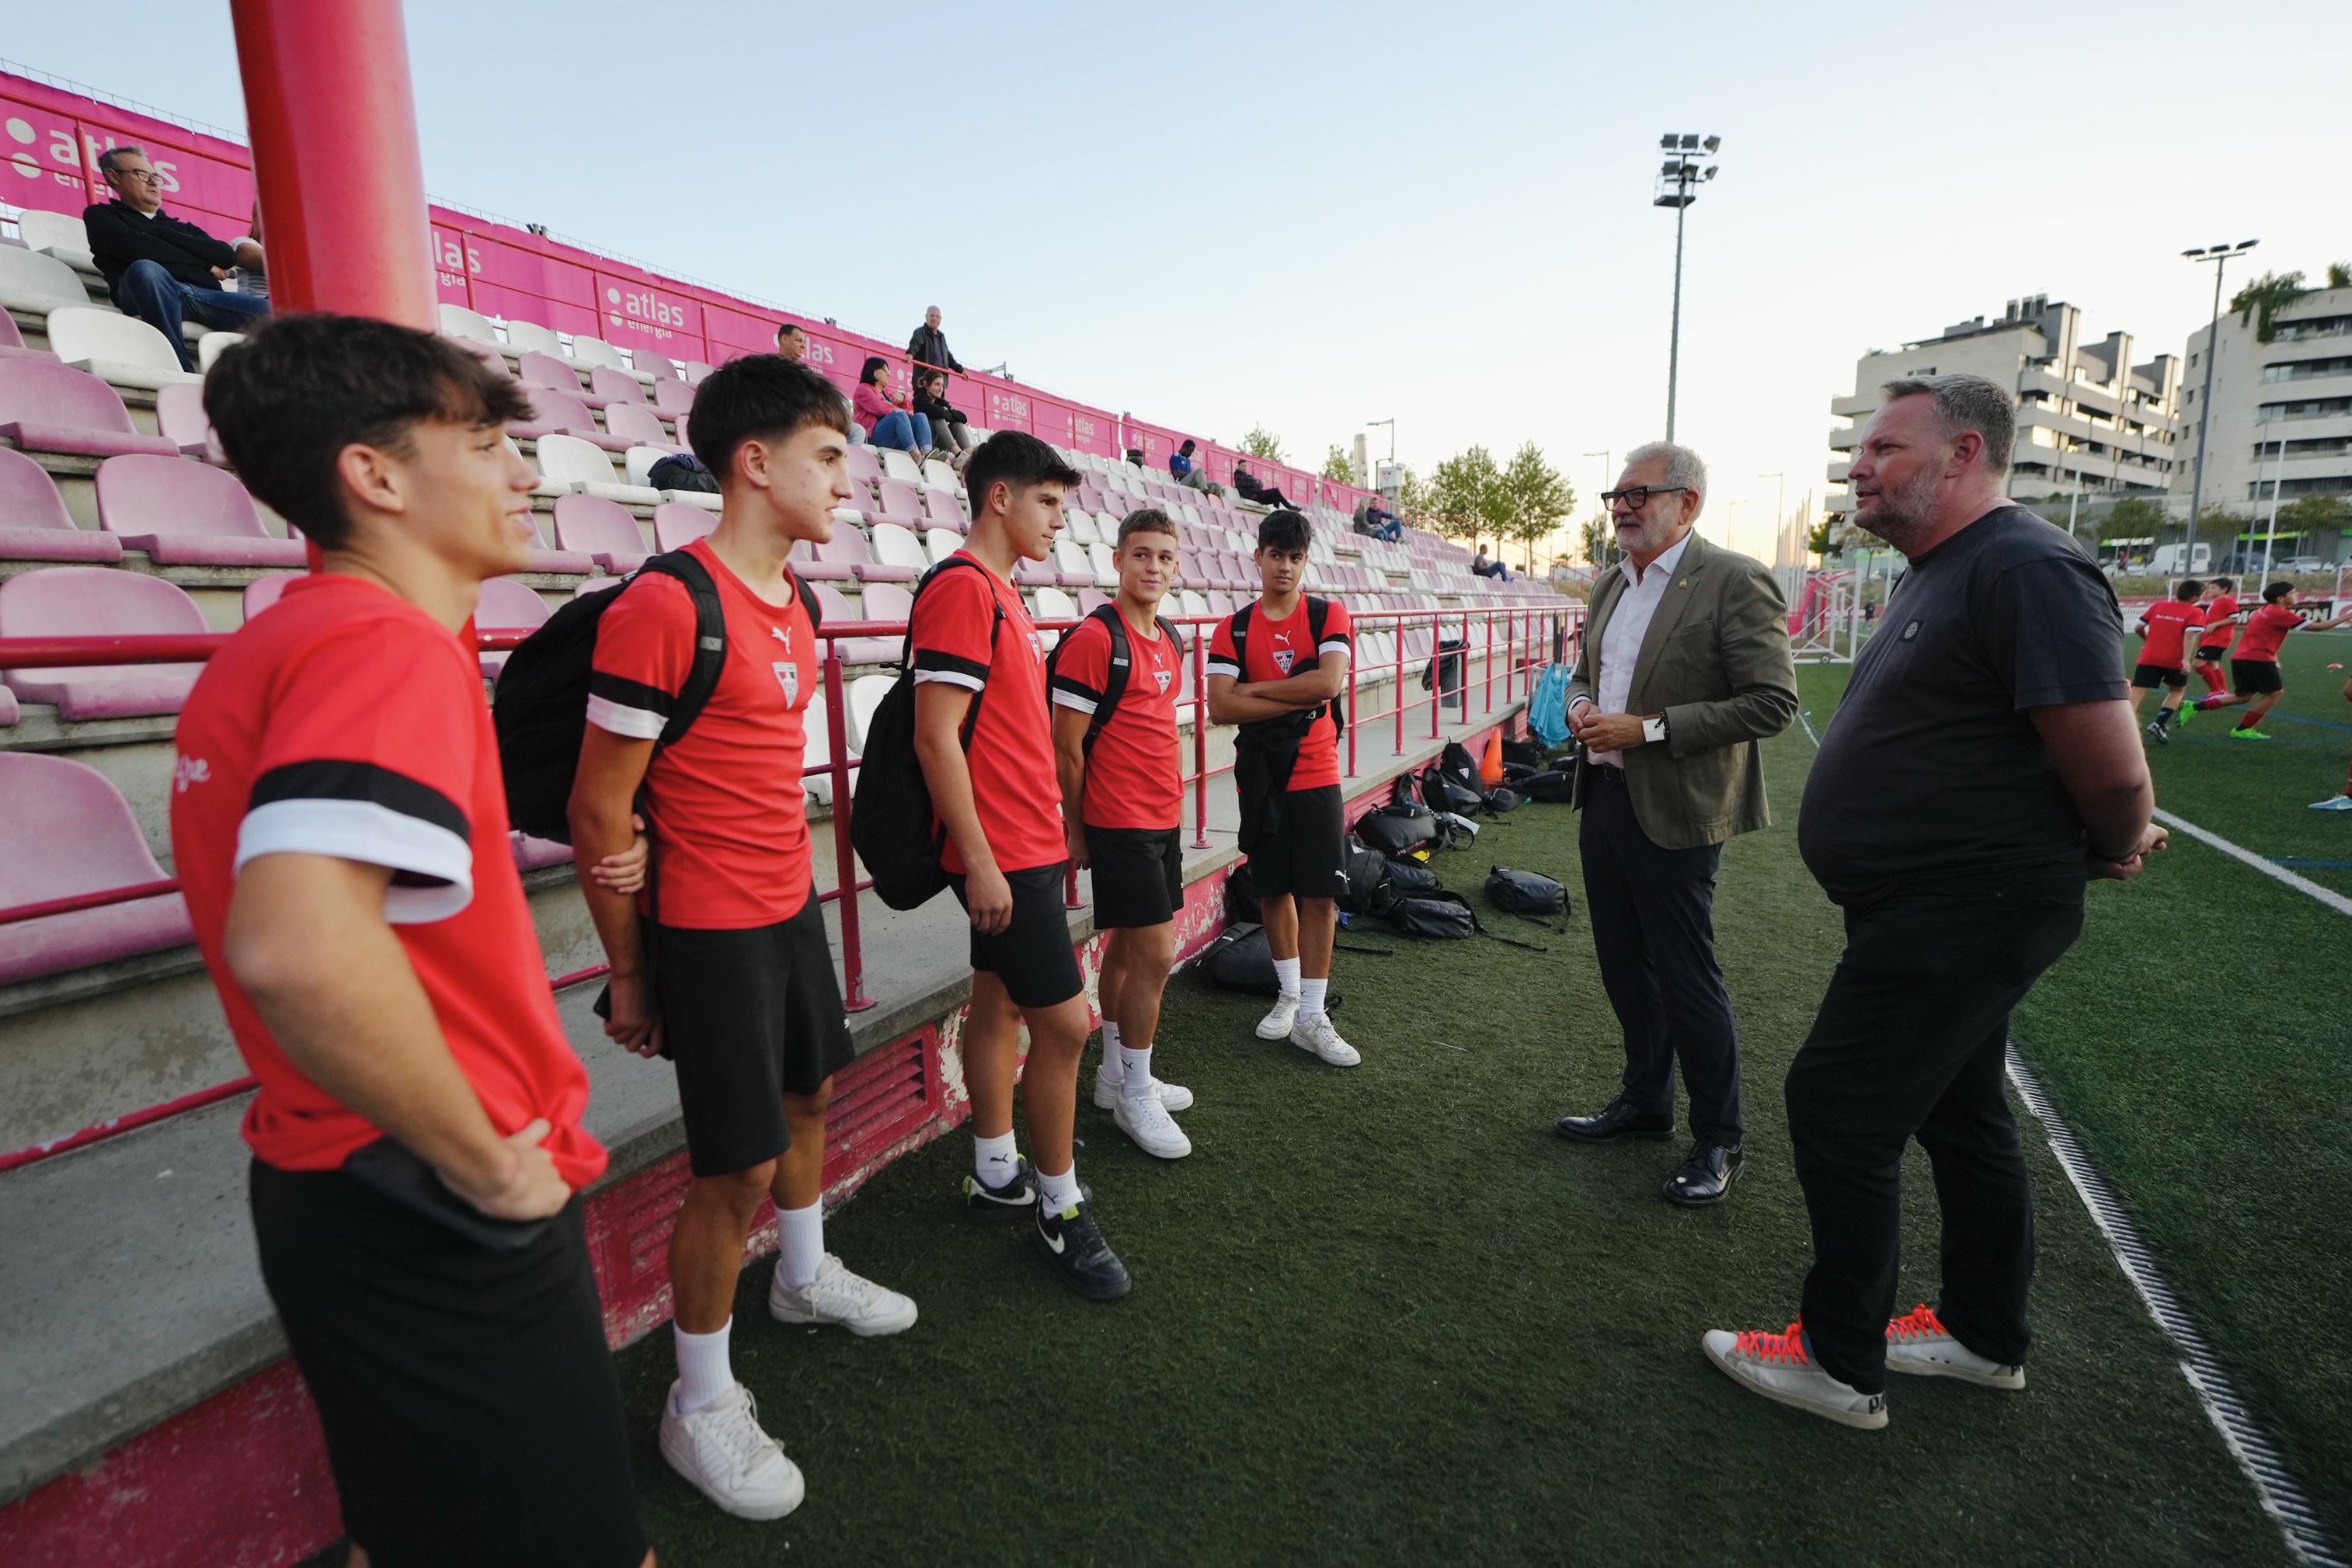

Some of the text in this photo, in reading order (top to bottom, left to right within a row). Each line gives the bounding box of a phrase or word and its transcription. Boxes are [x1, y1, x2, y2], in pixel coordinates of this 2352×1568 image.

[50, 130, 180, 193] ats
[433, 231, 482, 274] las
[626, 293, 684, 327] atlas
[628, 319, 673, 339] energia
[802, 336, 833, 365] las
[1002, 396, 1027, 416] atlas
